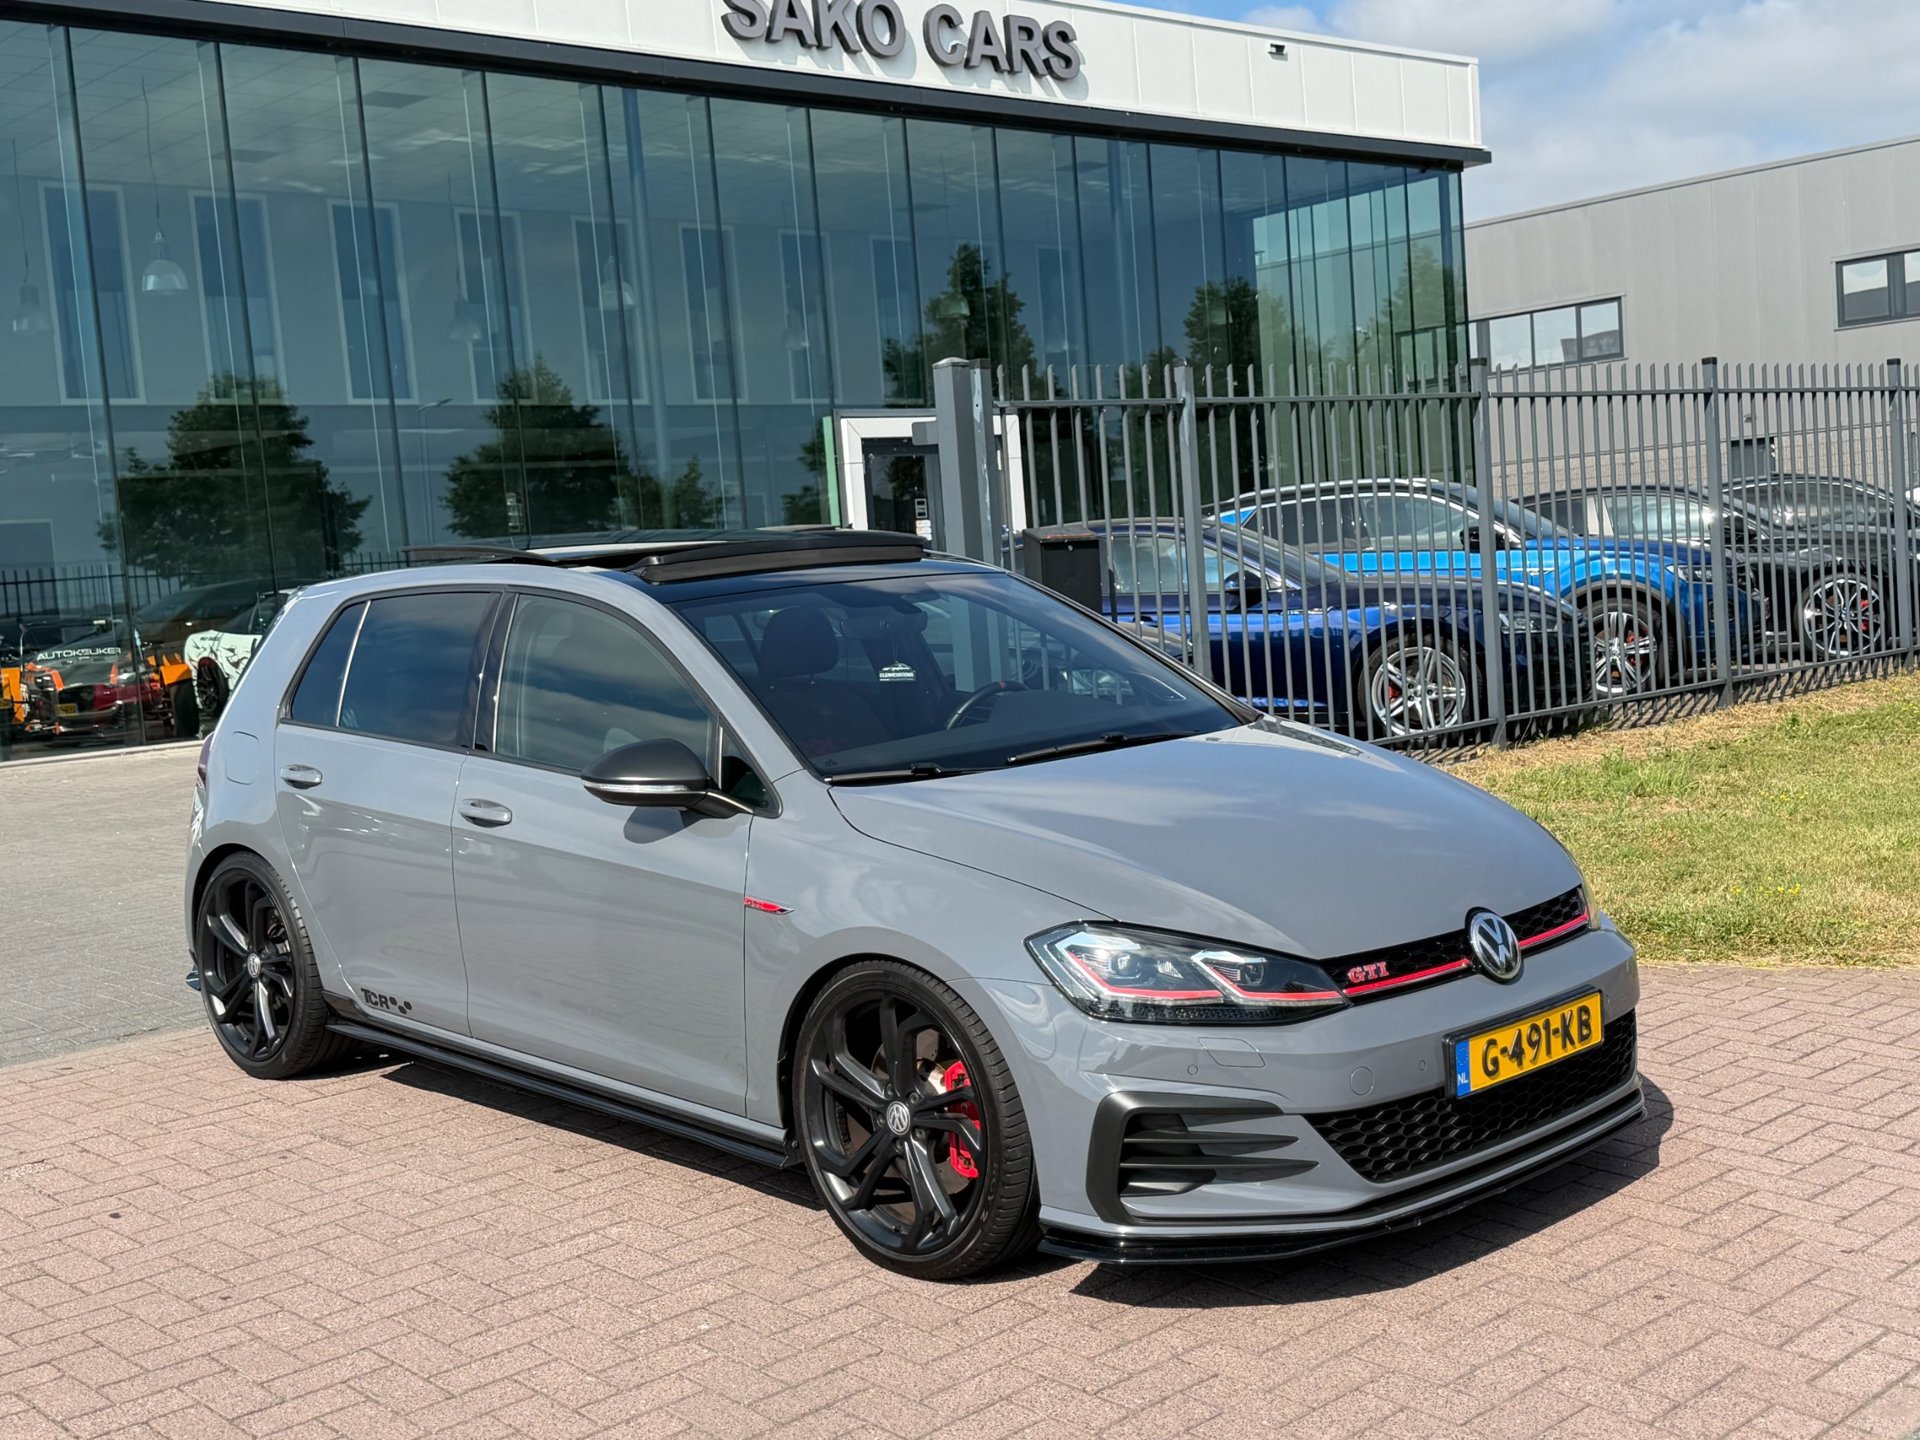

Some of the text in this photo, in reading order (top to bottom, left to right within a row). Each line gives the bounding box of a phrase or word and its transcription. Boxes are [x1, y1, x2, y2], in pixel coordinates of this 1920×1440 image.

[721, 0, 1081, 80] SAKO CARS
[1347, 961, 1389, 983] GTI
[360, 987, 390, 1010] TCR
[1482, 1004, 1592, 1079] G-491-KB
[1457, 1071, 1469, 1086] NL
